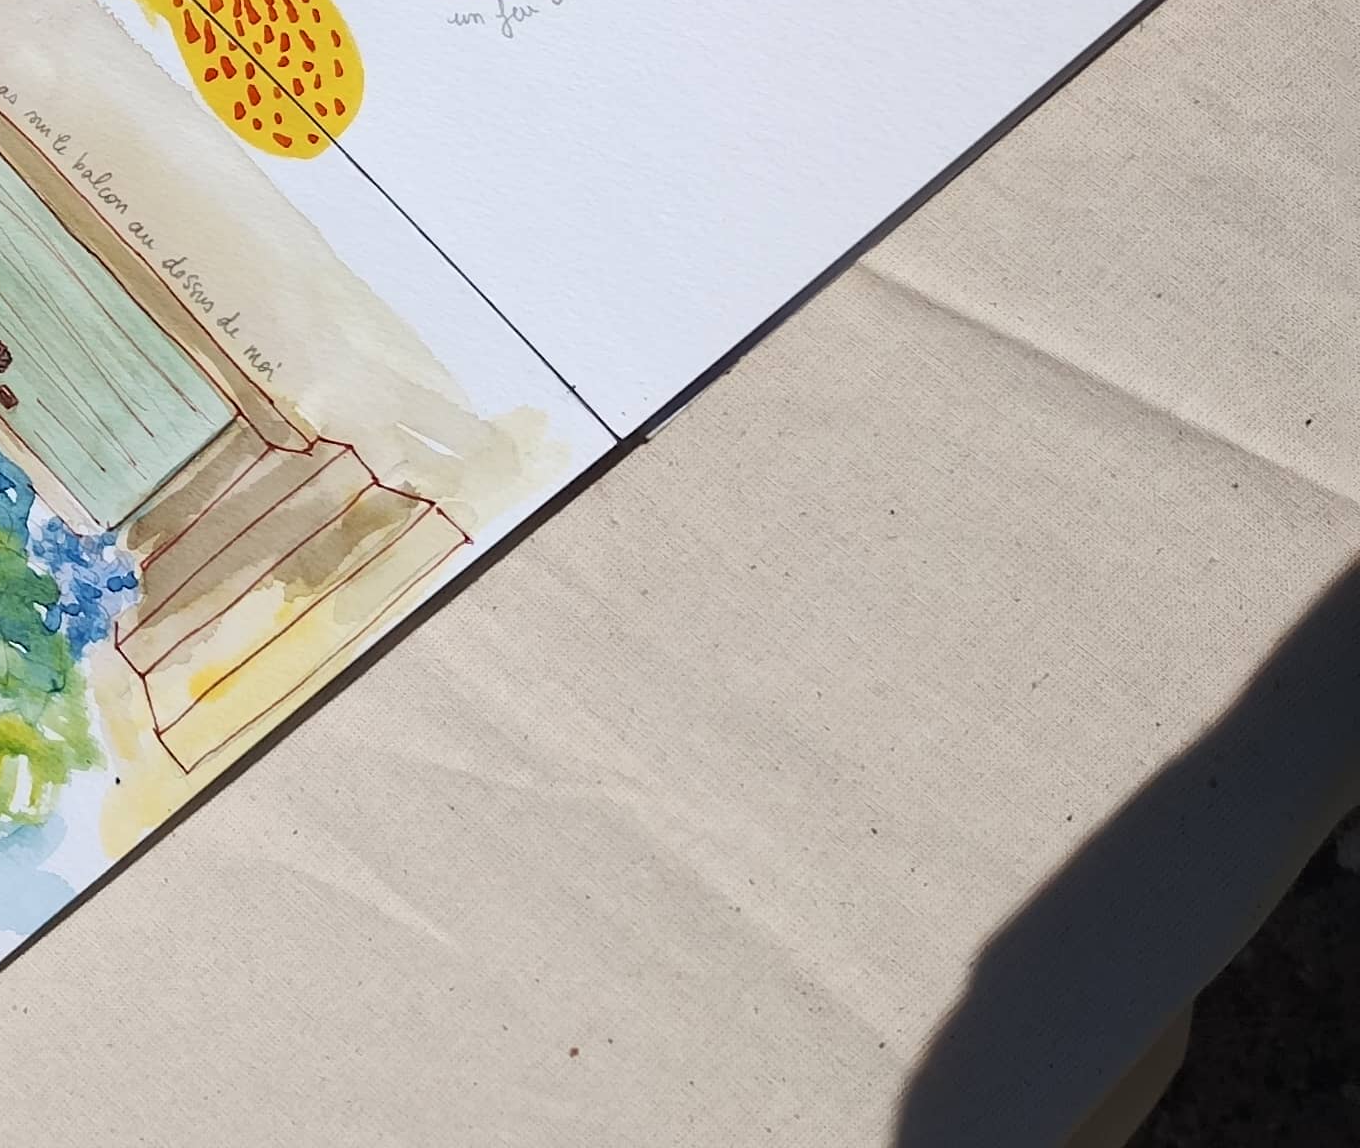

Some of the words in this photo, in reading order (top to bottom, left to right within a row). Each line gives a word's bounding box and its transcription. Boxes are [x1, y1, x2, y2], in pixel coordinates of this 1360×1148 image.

[447, 10, 485, 26] un
[72, 152, 128, 215] balcon
[128, 220, 155, 250] au
[162, 257, 215, 313] dessus
[217, 312, 240, 339] de
[243, 345, 282, 382] moi
